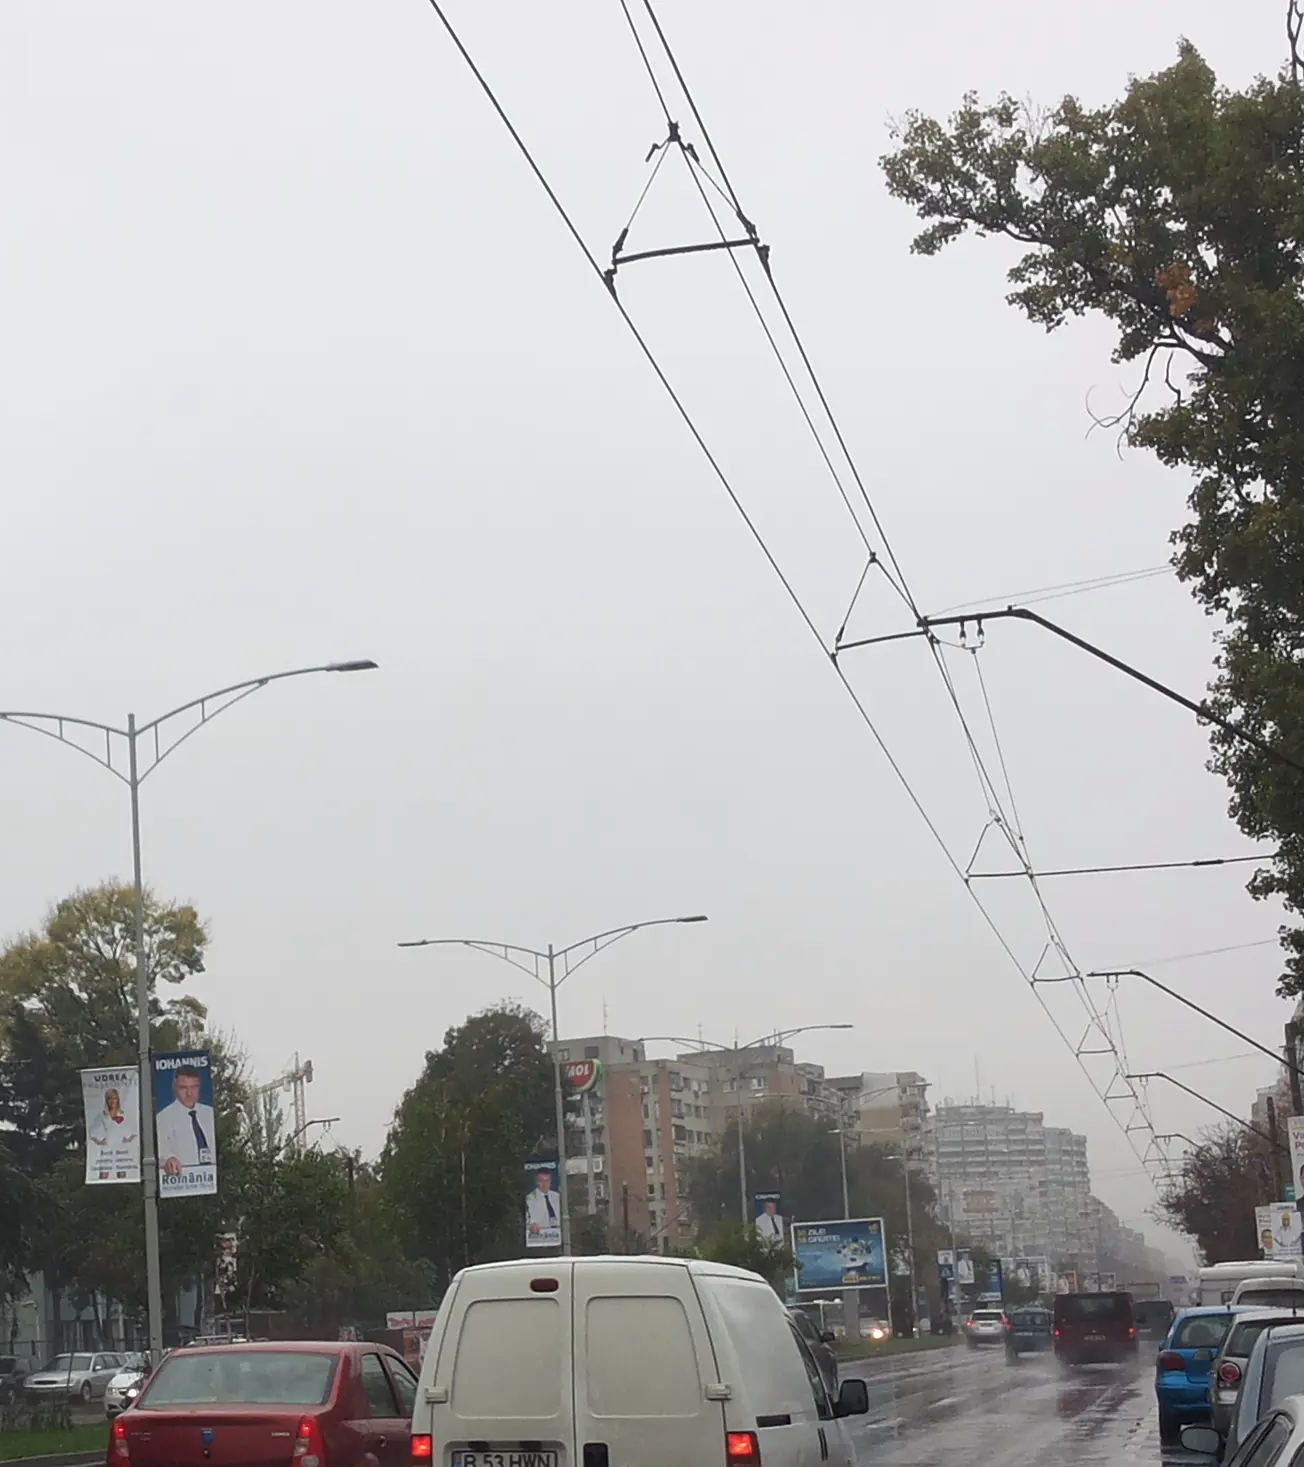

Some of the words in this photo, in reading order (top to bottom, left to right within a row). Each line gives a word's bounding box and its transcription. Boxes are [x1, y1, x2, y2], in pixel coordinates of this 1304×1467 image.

[155, 1056, 208, 1070] IOHANNIS
[94, 1072, 127, 1082] UDREA
[162, 1171, 214, 1185] România
[483, 1454, 504, 1467] 53
[509, 1454, 550, 1467] HWN
